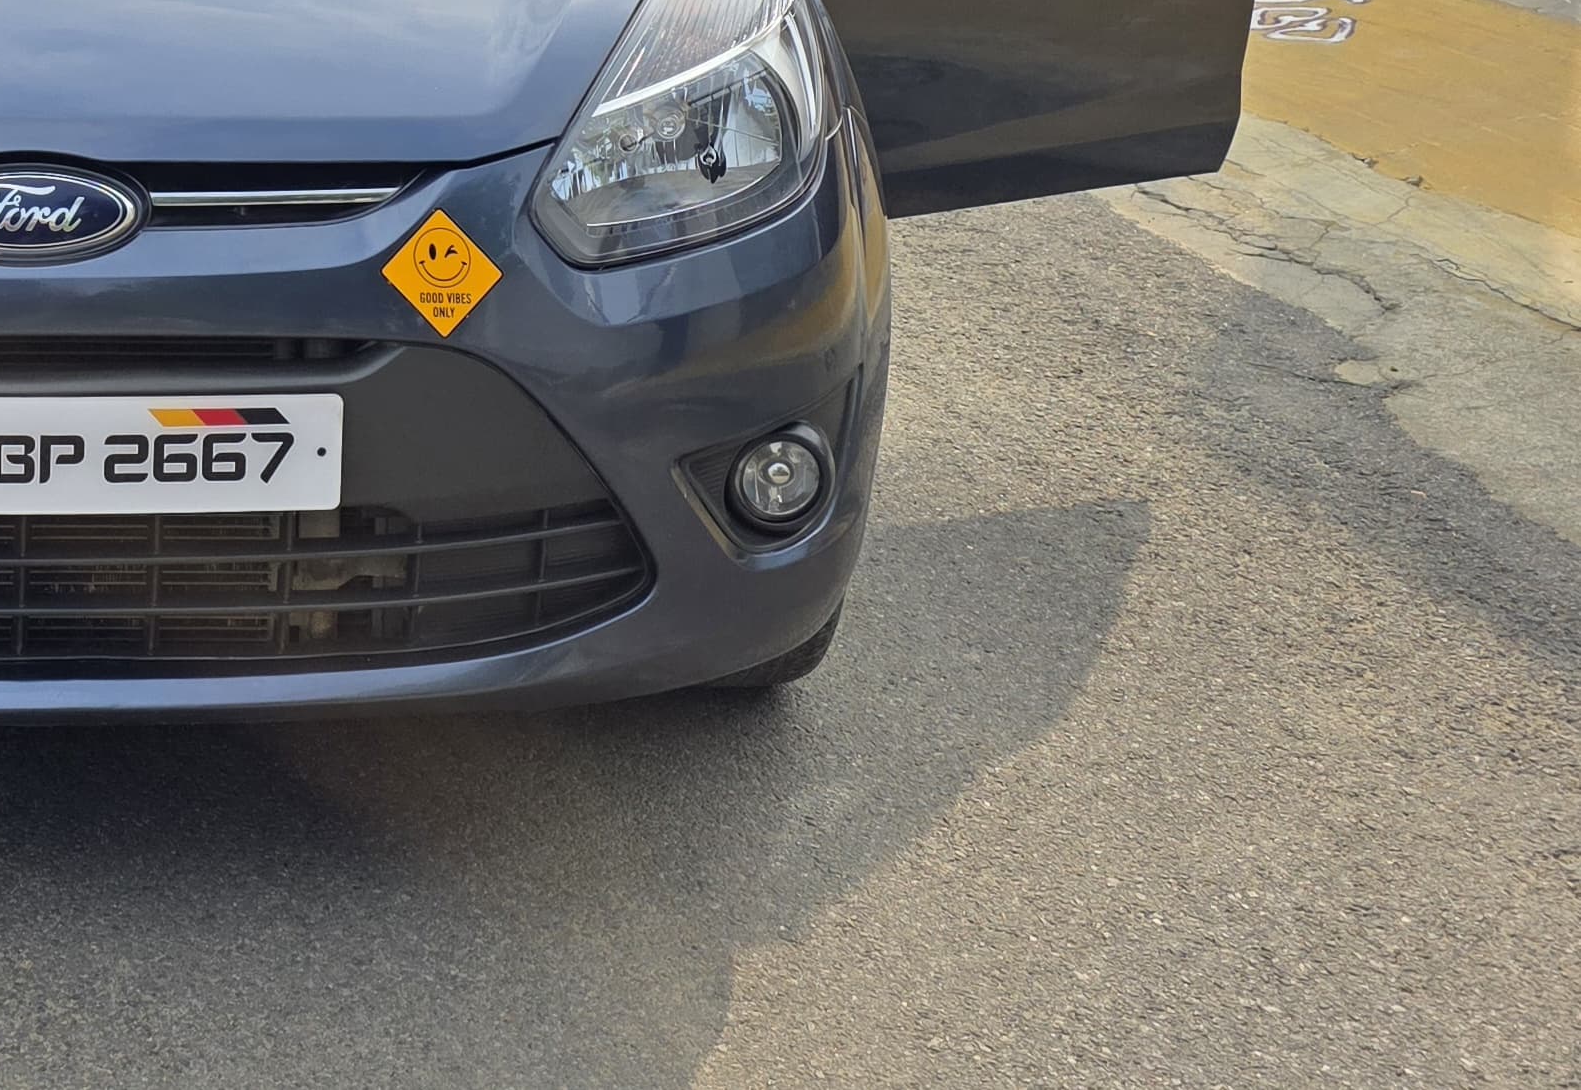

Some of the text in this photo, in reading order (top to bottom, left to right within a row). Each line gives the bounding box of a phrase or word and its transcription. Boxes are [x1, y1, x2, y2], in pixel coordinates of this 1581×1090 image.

[420, 292, 472, 304] GOOD VIBES
[433, 306, 455, 318] ONLY
[103, 431, 296, 484] 2667
